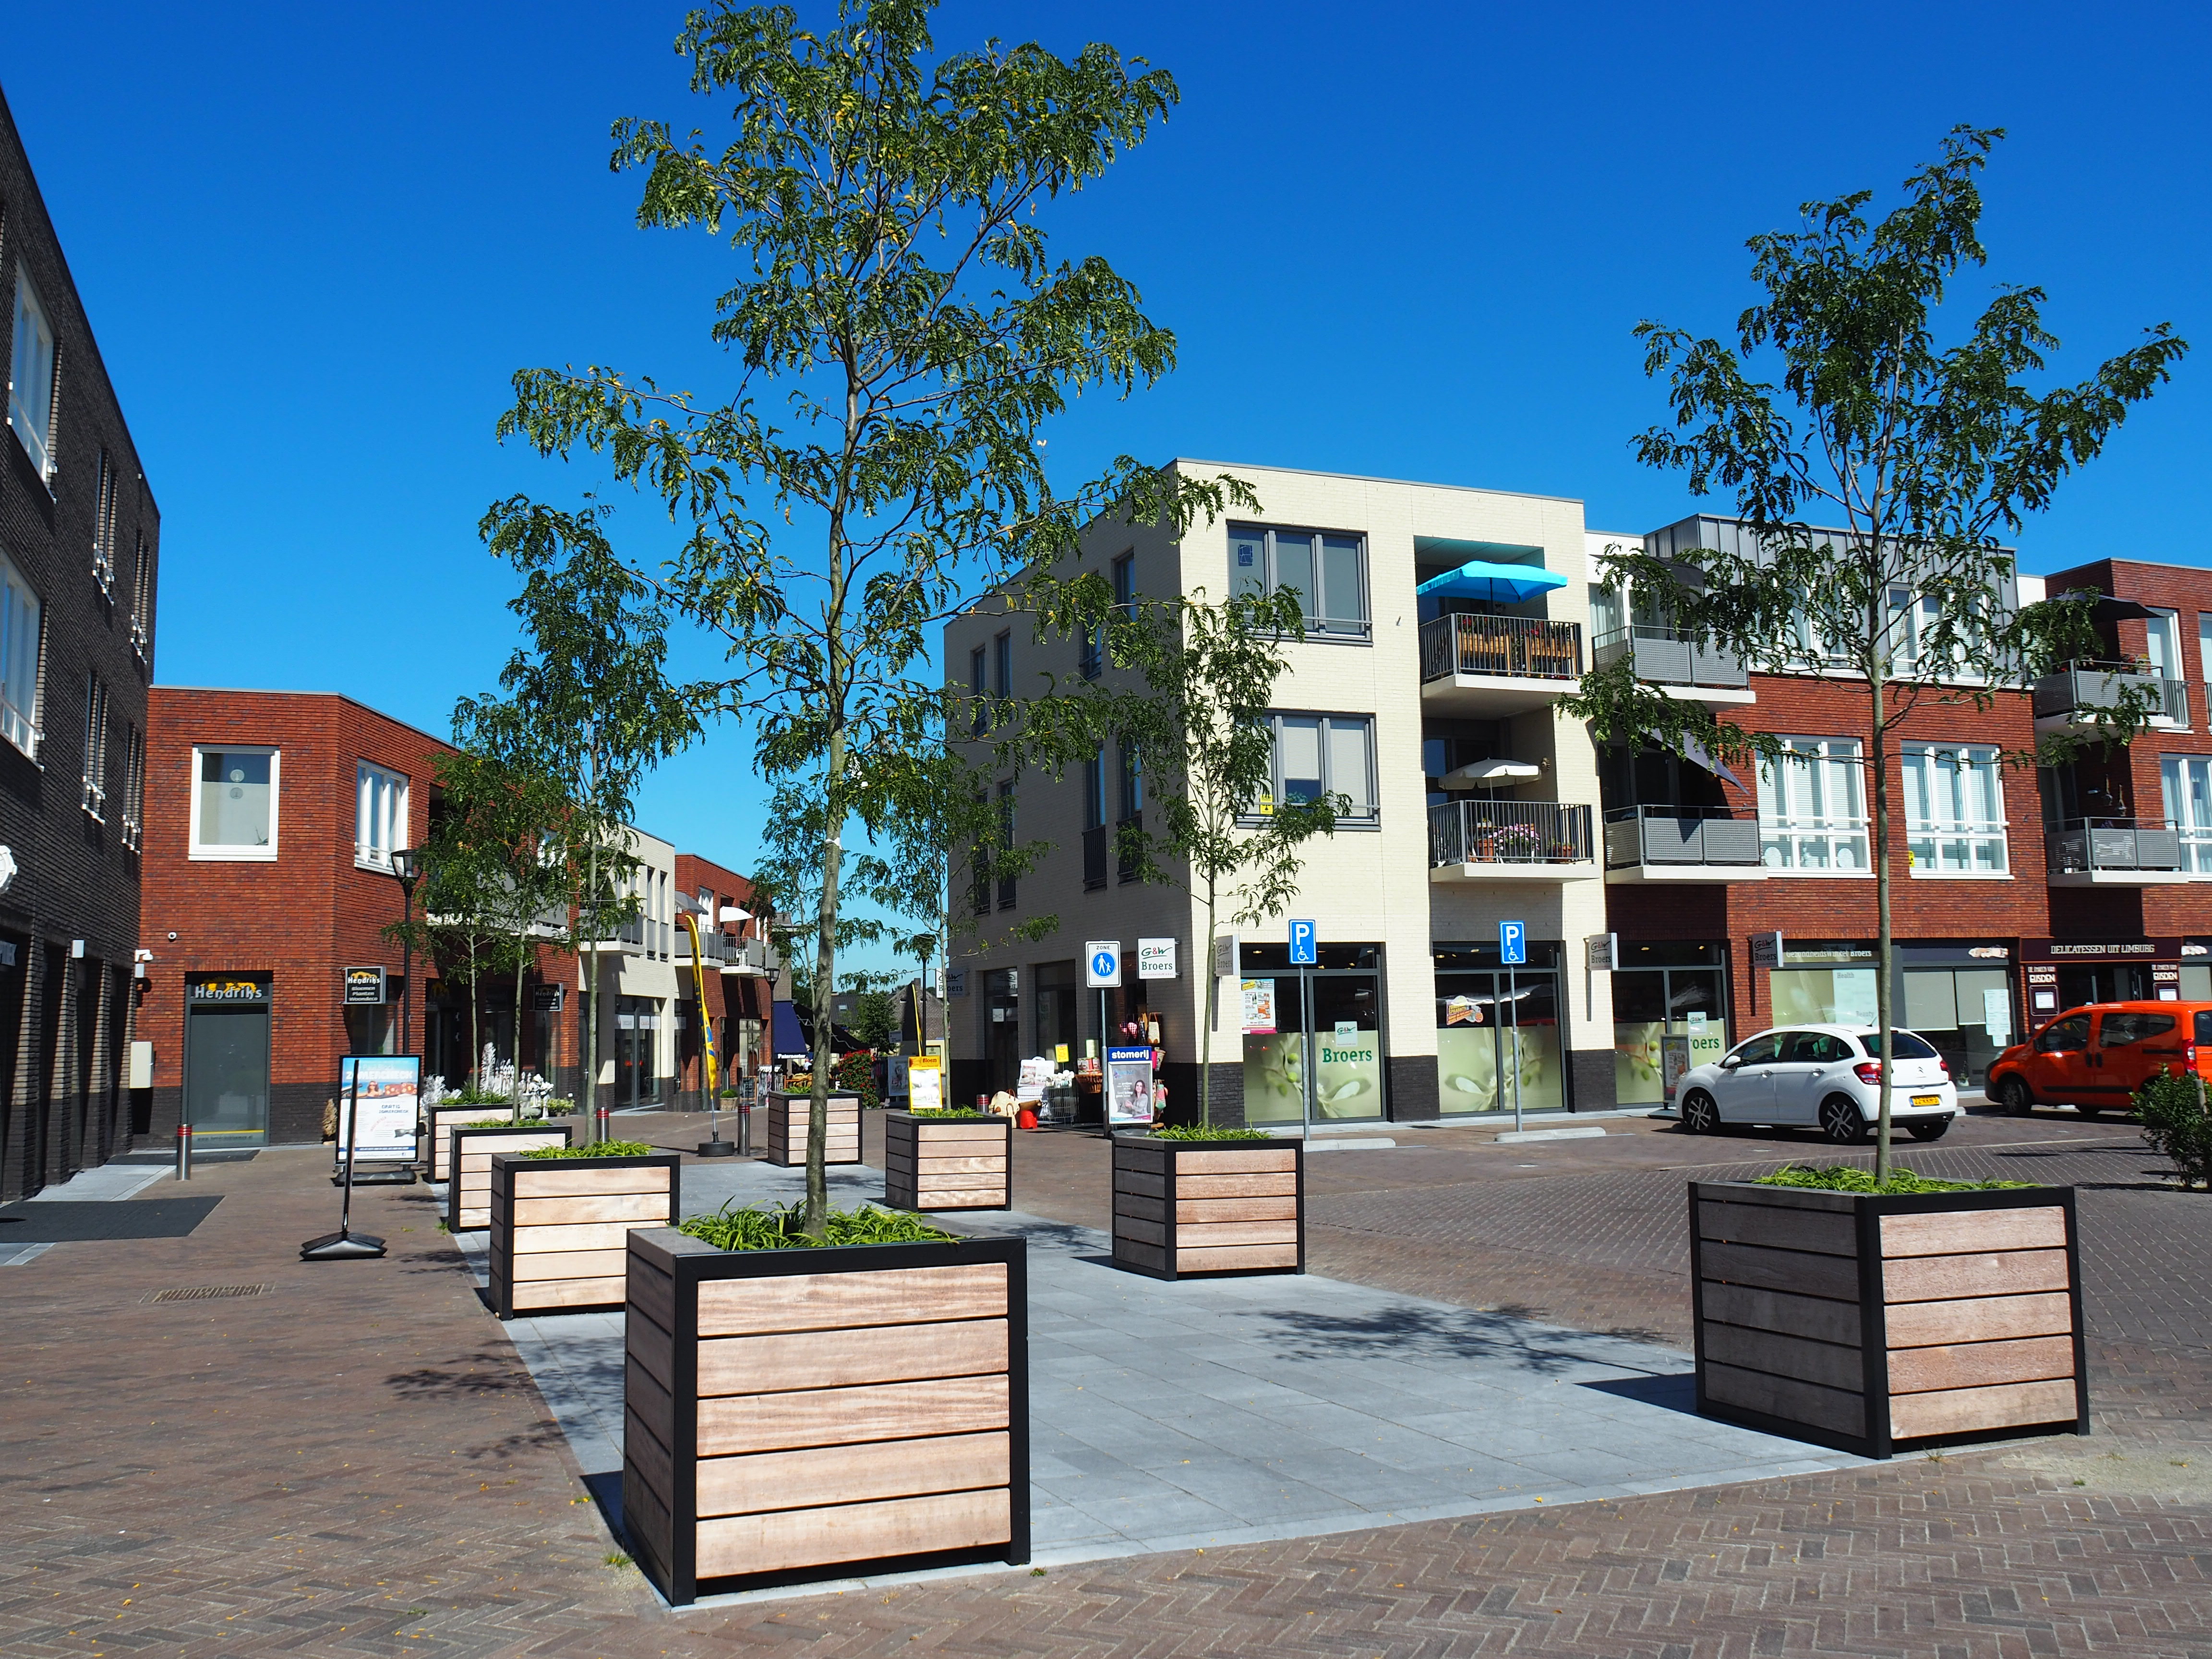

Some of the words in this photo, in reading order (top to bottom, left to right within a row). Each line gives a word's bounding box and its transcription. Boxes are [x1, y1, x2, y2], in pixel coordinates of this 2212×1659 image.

[1296, 924, 1310, 945] P
[1506, 926, 1519, 946] P
[1591, 941, 1611, 950] G&W
[1755, 939, 1776, 949] G&W
[2051, 945, 2106, 954] DELICATESSEN
[2107, 945, 2120, 953] UIT
[2121, 944, 2155, 953] LIMBURG
[1141, 947, 1173, 956] G&W
[1217, 959, 1232, 968] Broers
[1591, 955, 1611, 963] Broers
[1142, 962, 1173, 970] Broers
[348, 976, 381, 985] Hendriks
[194, 986, 263, 1000] Hendriks
[1690, 1038, 1719, 1049] oers
[1111, 1049, 1149, 1059] stomerij
[1322, 1048, 1372, 1062] Broers
[346, 1071, 413, 1080] ZMERCHECK
